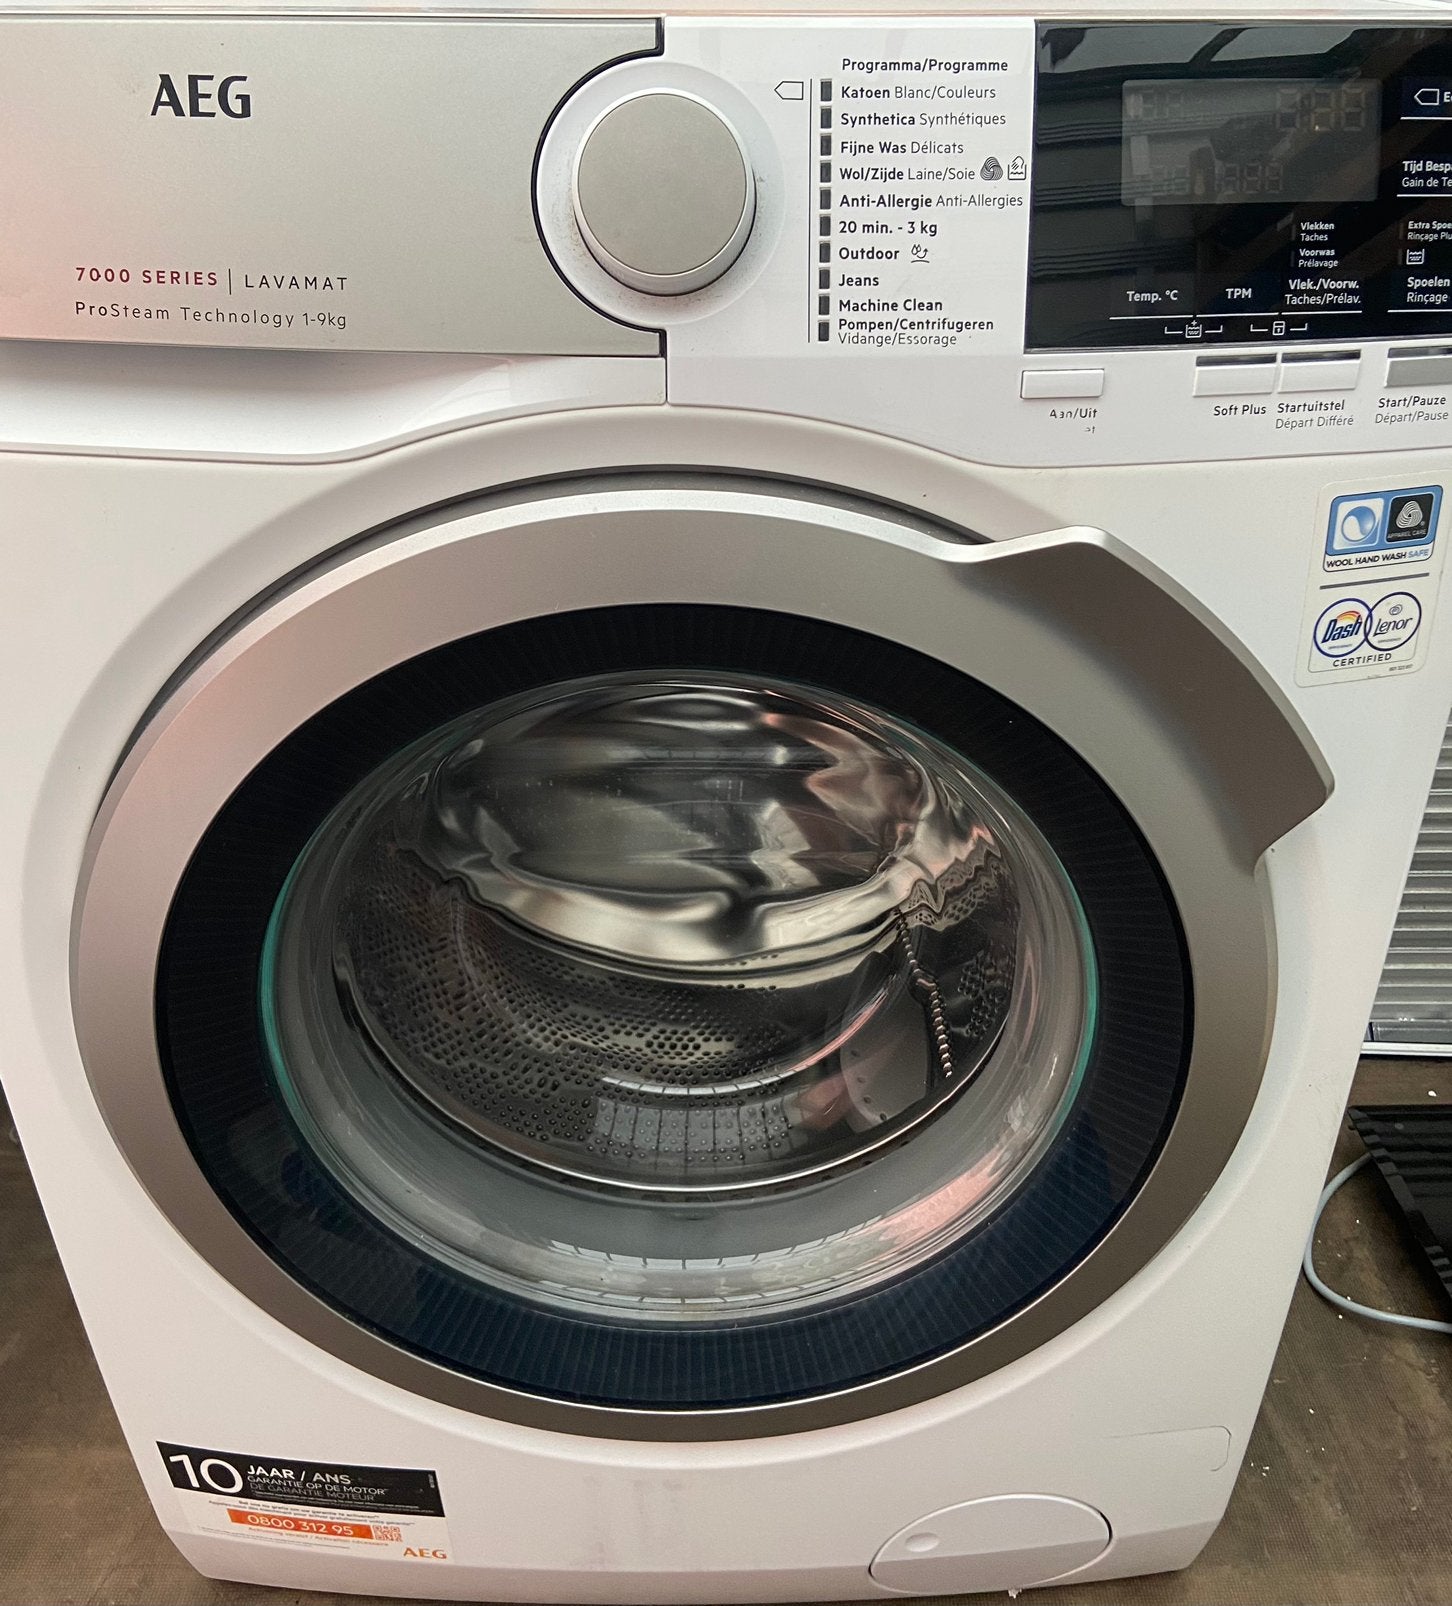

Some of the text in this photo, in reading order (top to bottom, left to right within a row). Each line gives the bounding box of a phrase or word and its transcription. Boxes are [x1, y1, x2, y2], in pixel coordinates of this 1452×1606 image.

[841, 58, 1008, 73] Programma/Programme
[150, 74, 251, 118] AEG
[841, 85, 996, 100] Katoen Blanc/Couleurs
[1443, 91, 1452, 103] E
[840, 112, 1006, 129] Synthetica Synthétiques
[840, 141, 964, 157] Fijne Was Délicats
[1402, 160, 1423, 174] Tijd
[840, 167, 975, 183] Wol/Zijde Laine/Soie
[1402, 176, 1424, 187] Gain
[1426, 176, 1439, 187] de
[840, 194, 1023, 209] Anti-Allergie Anti-Allergies
[838, 221, 857, 234] 20
[862, 221, 894, 234] min.
[907, 221, 916, 234] 3
[920, 220, 938, 236] kg
[1300, 222, 1335, 231] Vlekken
[1408, 221, 1430, 230] Extra
[1300, 232, 1329, 242] Taches
[1407, 231, 1439, 242] Rinçage
[838, 247, 900, 260] Outdoor
[1299, 248, 1336, 257] Voorwas
[1298, 258, 1339, 269] Prélavage
[75, 267, 218, 286] 7000 SERIES
[245, 274, 348, 291] LAVAMAT
[838, 274, 879, 287] Jeans
[1407, 275, 1451, 290] Spoelen
[1288, 278, 1360, 291] Vlek./Voorw.
[1126, 289, 1179, 304] Temp. °C
[1226, 287, 1252, 300] TPM
[1284, 292, 1362, 306] Taches/Prélav.
[1407, 291, 1449, 305] Rinçage
[839, 298, 943, 312] Machine Clean
[75, 301, 346, 330] ProSteam Technology 1-9kg
[838, 318, 994, 333] Pompen/Centrifugeren
[838, 332, 957, 347] Vidange/Essorage
[1277, 399, 1345, 414] Startuitstel
[1378, 395, 1447, 409] Start/Pauze
[1213, 404, 1267, 417] Soft Plus
[1375, 410, 1449, 425] Départ/Pause
[1275, 416, 1354, 431] Départ Différé
[1326, 548, 1430, 568] WOOL HAND WASH SAFE
[1321, 614, 1363, 644] Dash
[1372, 617, 1414, 637] Lenor
[1332, 652, 1392, 668] CERTIFIED
[168, 1454, 244, 1494] 10
[247, 1464, 351, 1485] JAAR / ANS
[247, 1475, 304, 1489] GARANTIE
[305, 1481, 322, 1490] OP
[325, 1483, 340, 1492] DE
[267, 1485, 323, 1498] GARANTIE
[247, 1514, 295, 1529] 0800
[298, 1521, 329, 1533] 312
[331, 1525, 355, 1536] 95
[403, 1547, 448, 1560] AEG
